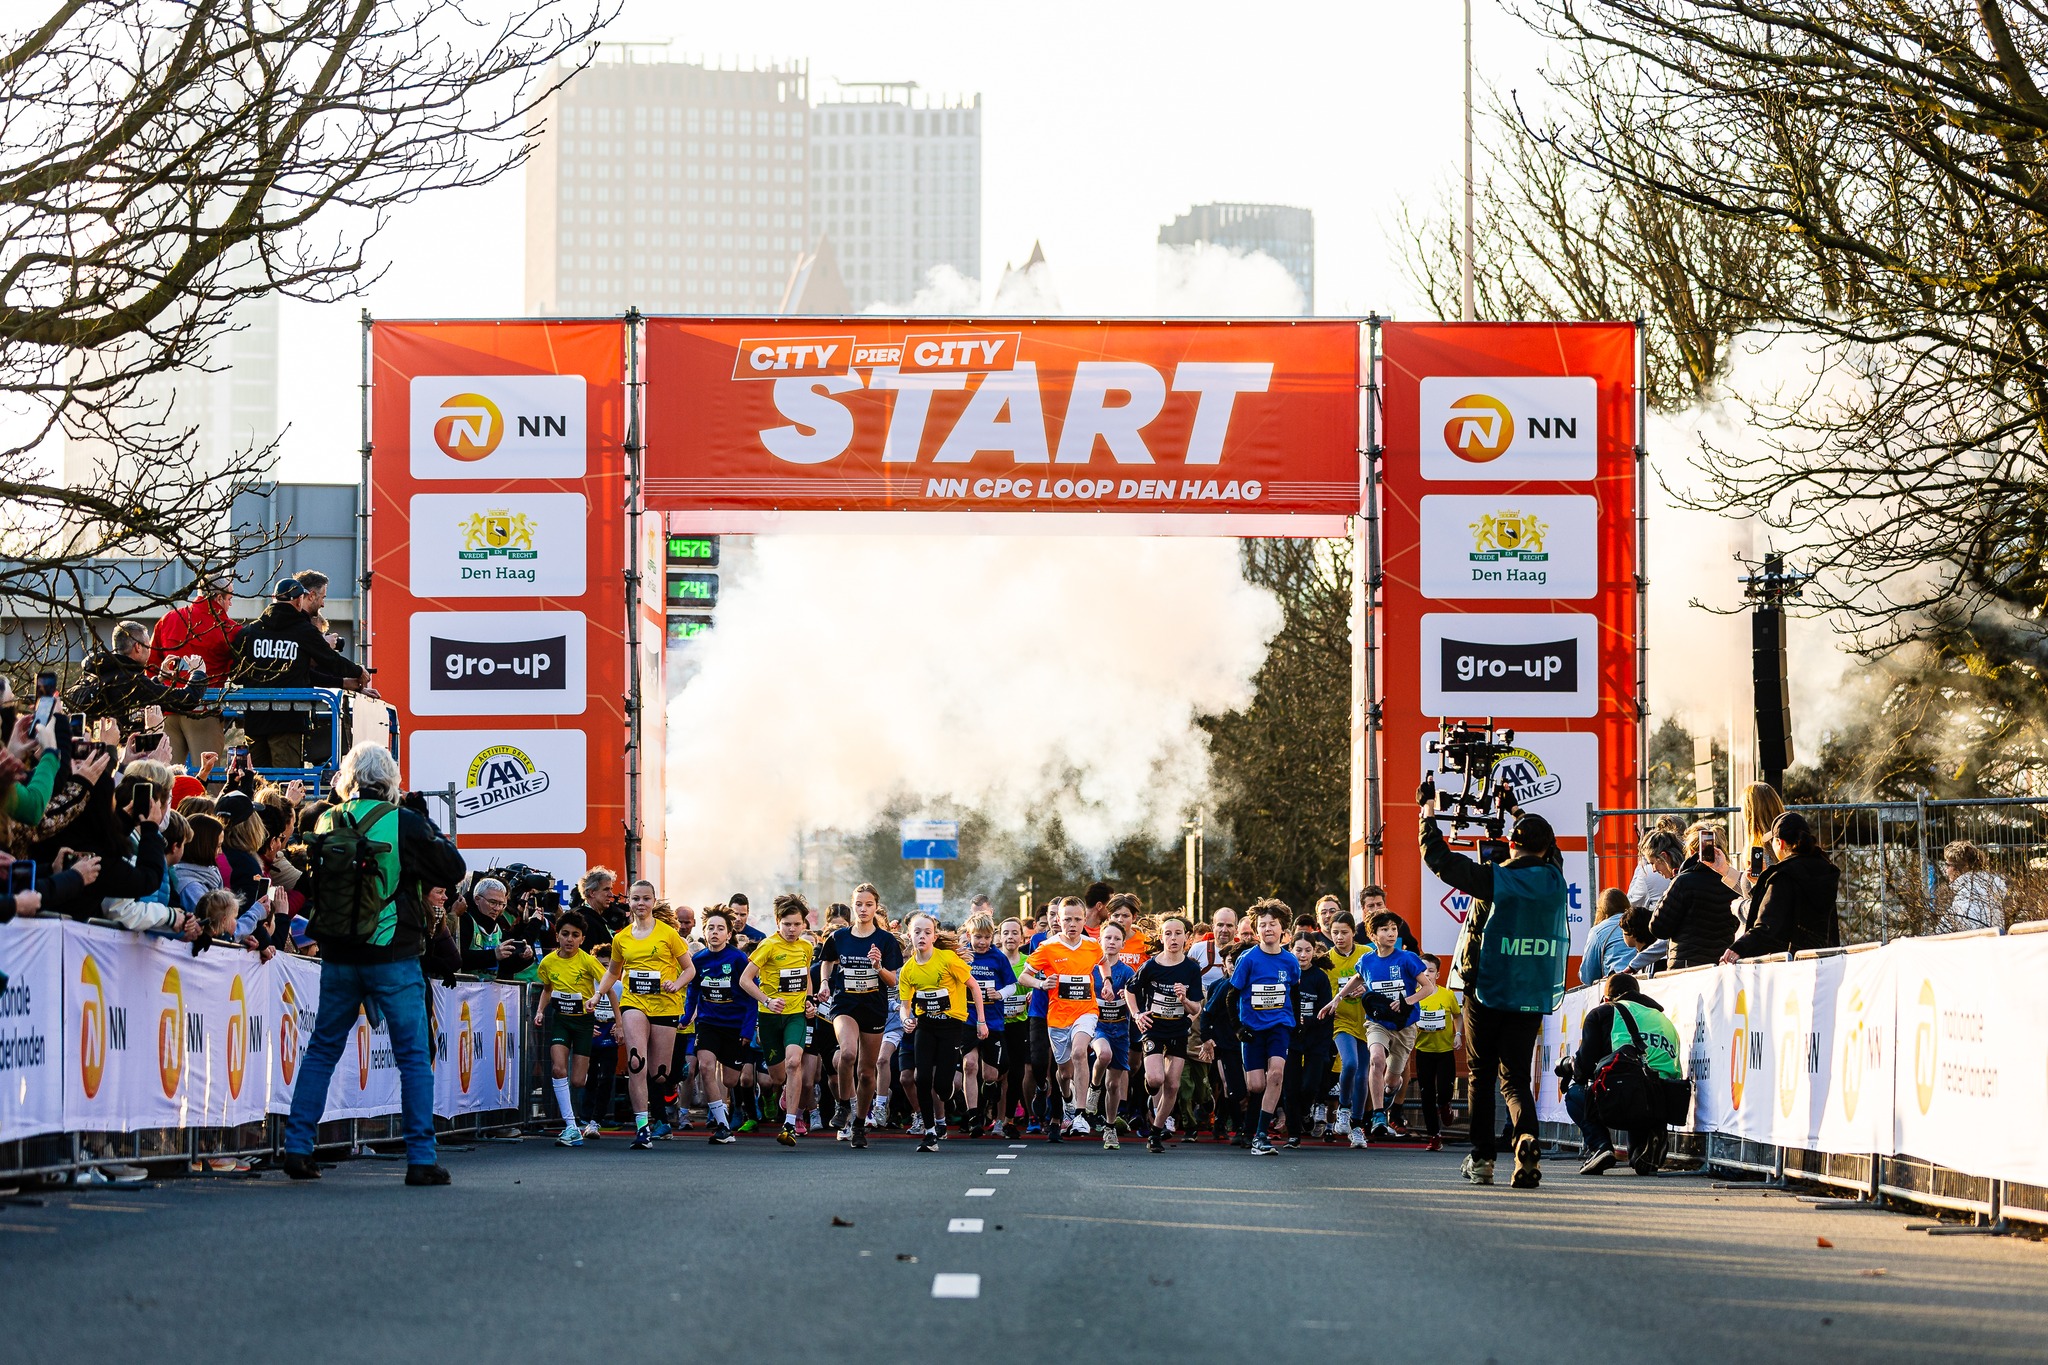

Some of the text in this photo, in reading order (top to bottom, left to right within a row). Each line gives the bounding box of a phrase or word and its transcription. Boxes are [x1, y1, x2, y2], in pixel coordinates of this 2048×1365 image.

[749, 339, 1006, 371] CITY PIER CITY
[517, 415, 567, 437] NN
[758, 360, 1275, 465] START
[1527, 417, 1577, 439] NN
[925, 477, 1262, 501] NN CPC LOOP DEN HAAG
[669, 539, 711, 558] 4576
[460, 566, 536, 583] Den Haag
[1471, 568, 1547, 585] Den Haag
[679, 580, 711, 599] 741
[253, 638, 299, 661] GOLAZO
[445, 652, 551, 681] gro-up
[1456, 654, 1563, 683] gro-up
[469, 763, 480, 778] ALL
[478, 746, 510, 763] ACTIVITY
[511, 748, 531, 766] DRINK
[487, 760, 524, 790] AA
[1502, 762, 1536, 787] AA
[480, 780, 533, 807] DRINK
[1516, 784, 1544, 802] INK
[1500, 936, 1557, 957] MEDI
[0, 974, 31, 1018] ionale
[108, 1006, 128, 1051] NN
[187, 1013, 204, 1053] NN
[249, 1015, 263, 1053] NN
[0, 1026, 45, 1071] derlanden
[473, 1031, 483, 1059] NN
[1639, 1032, 1677, 1059] PERS
[1749, 1031, 1764, 1070] NN
[1867, 1025, 1882, 1069] NN
